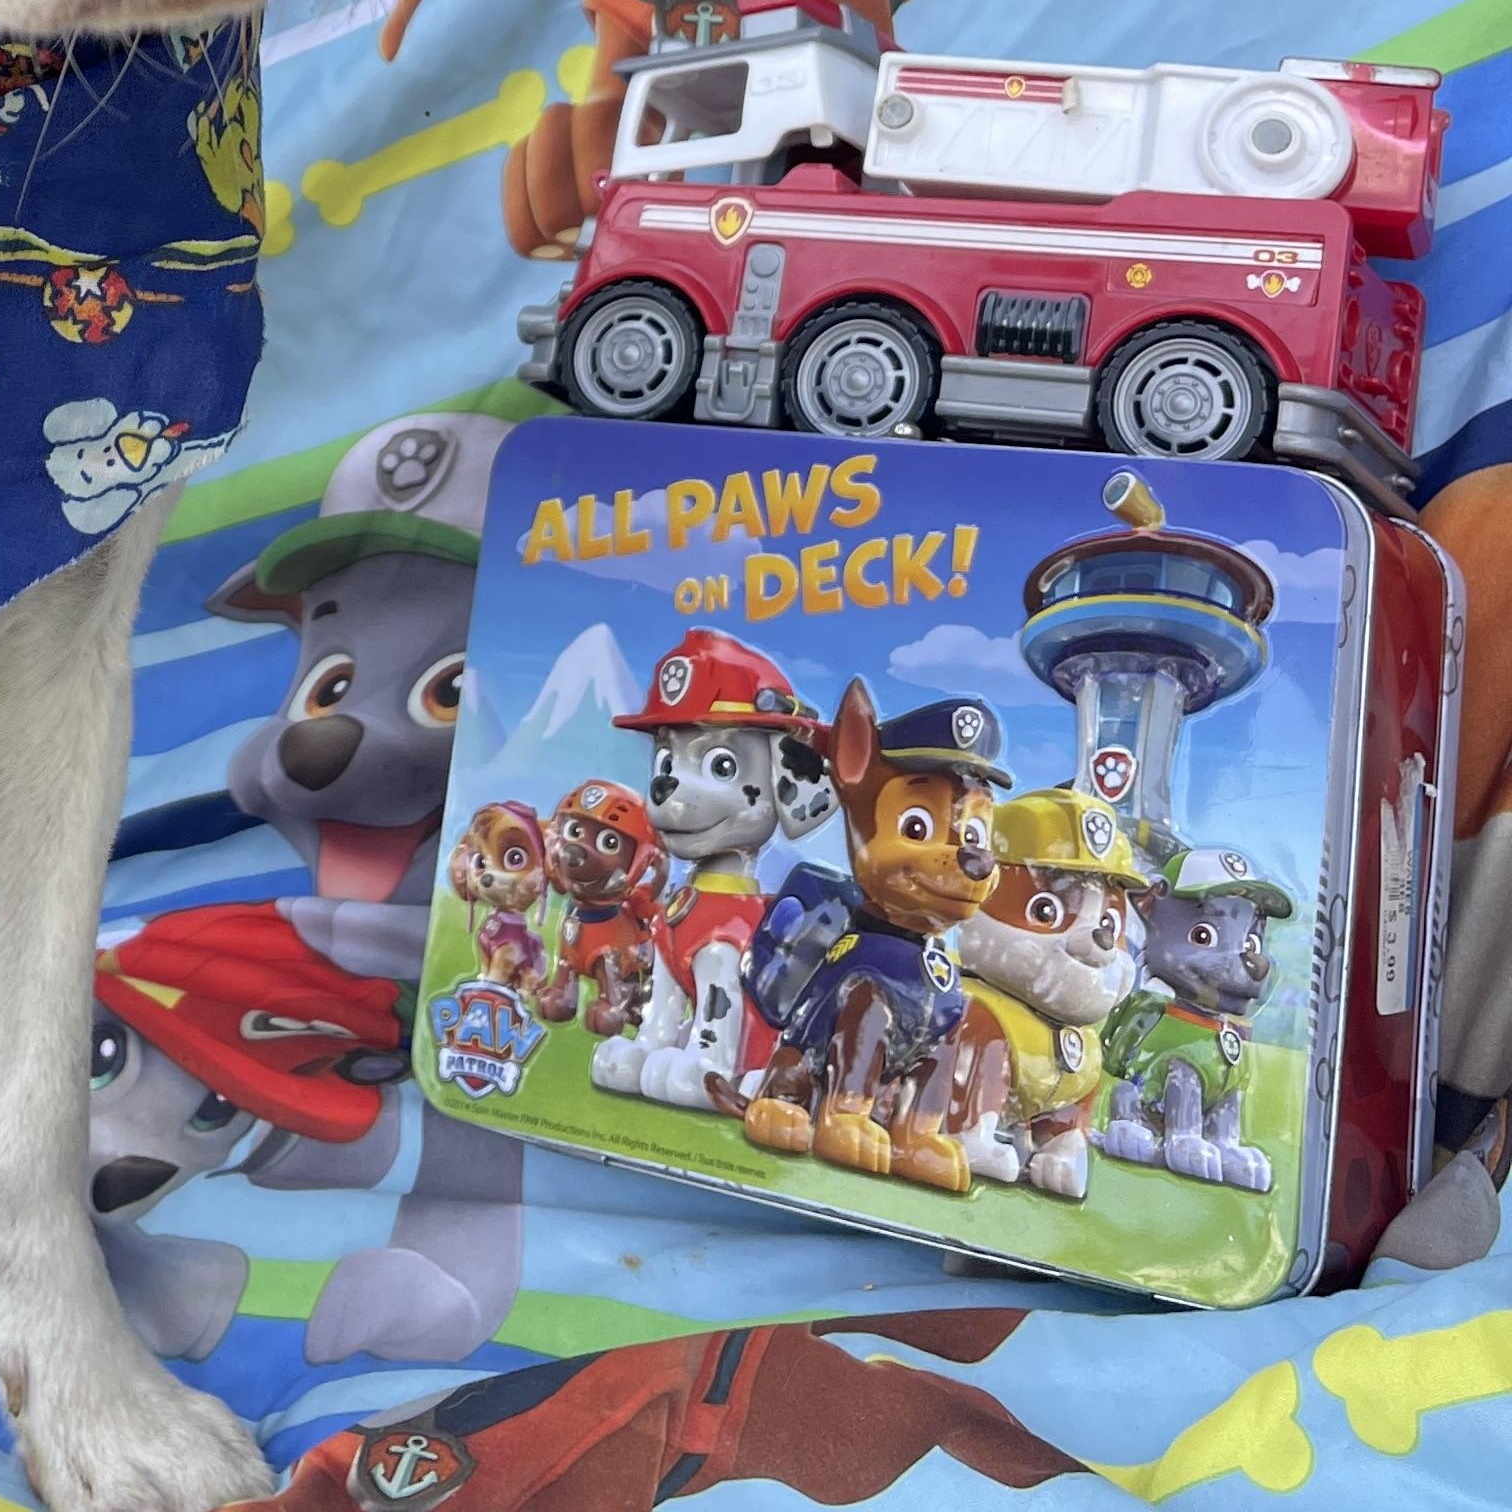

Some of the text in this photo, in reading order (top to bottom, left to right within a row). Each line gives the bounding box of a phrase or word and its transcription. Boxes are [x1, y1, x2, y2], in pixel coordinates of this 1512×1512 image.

[1254, 249, 1298, 264] 03
[521, 453, 882, 566] ALL PAWS
[744, 524, 979, 623] DECK!
[428, 996, 548, 1063] PAW
[445, 1054, 506, 1083] PATROL
[622, 1135, 650, 1152] Rights
